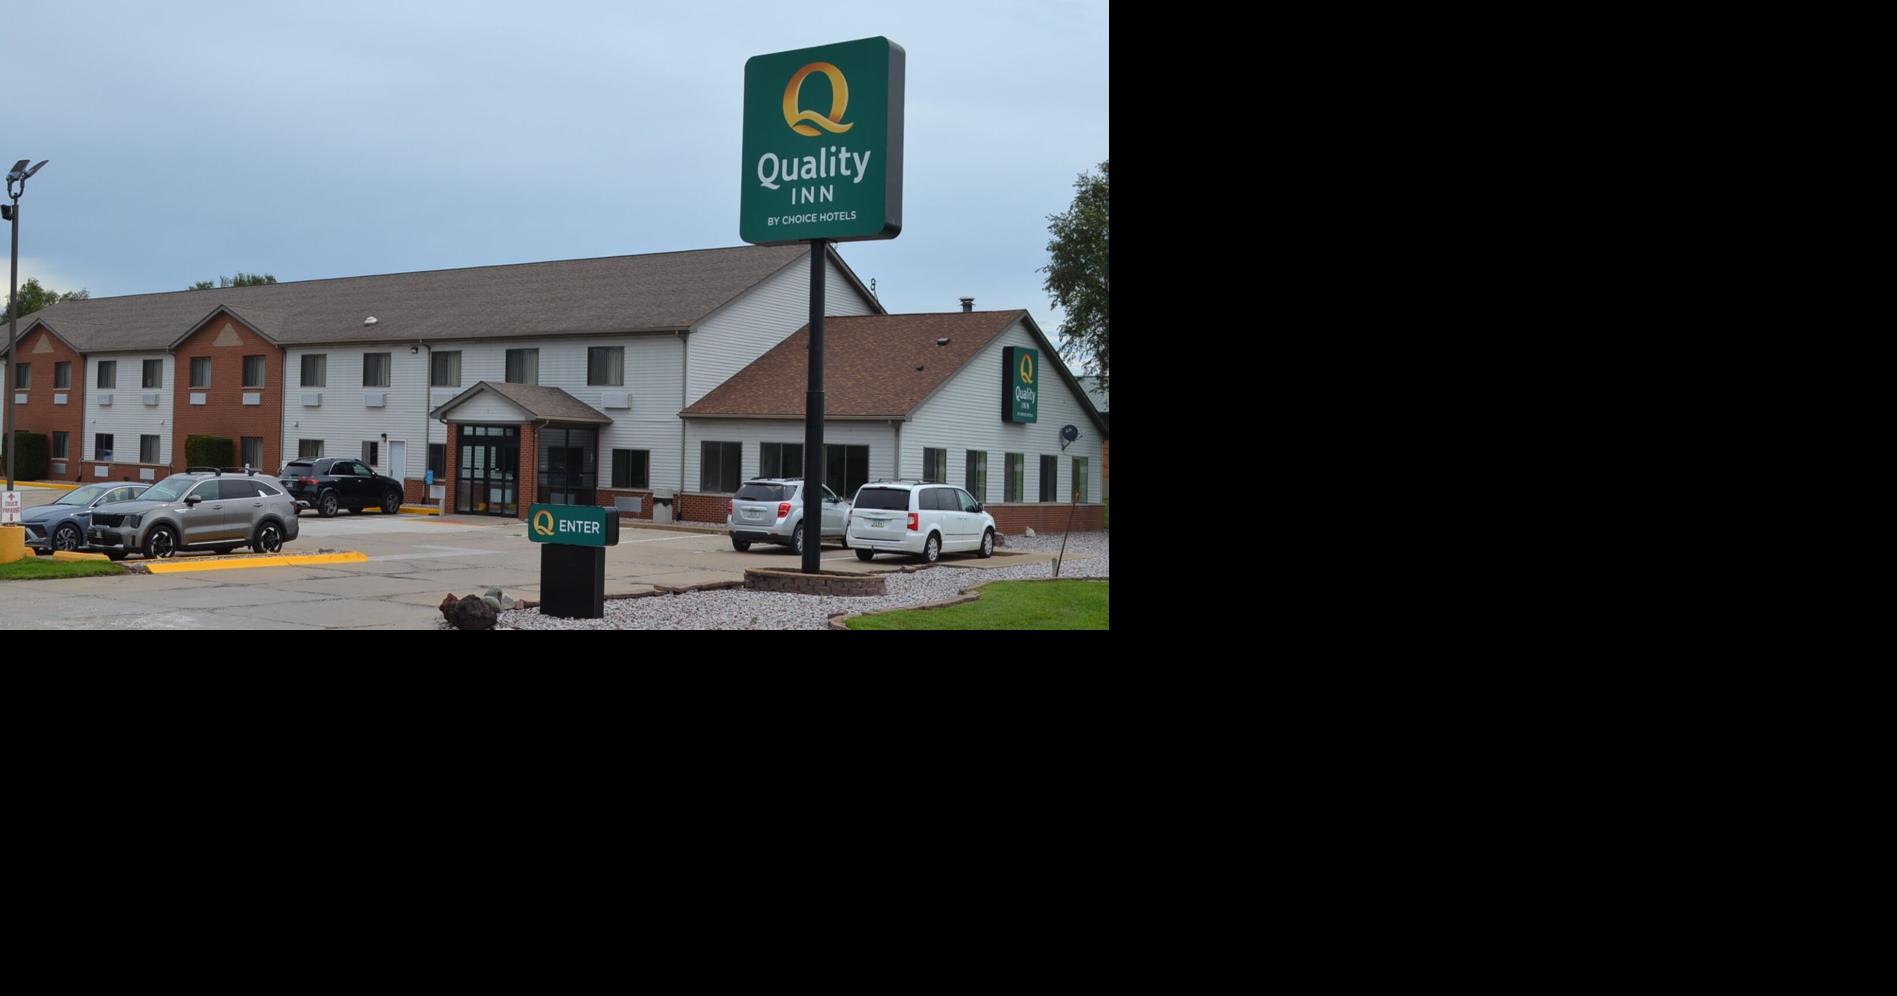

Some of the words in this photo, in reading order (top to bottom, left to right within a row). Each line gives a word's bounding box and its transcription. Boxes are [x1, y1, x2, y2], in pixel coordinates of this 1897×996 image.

[757, 145, 871, 190] Quality
[791, 184, 833, 205] INN
[767, 217, 780, 226] BY
[782, 213, 817, 225] CHOICE
[819, 210, 857, 222] HOTELS
[1015, 385, 1036, 404] Quality
[559, 519, 600, 535] ENTER
